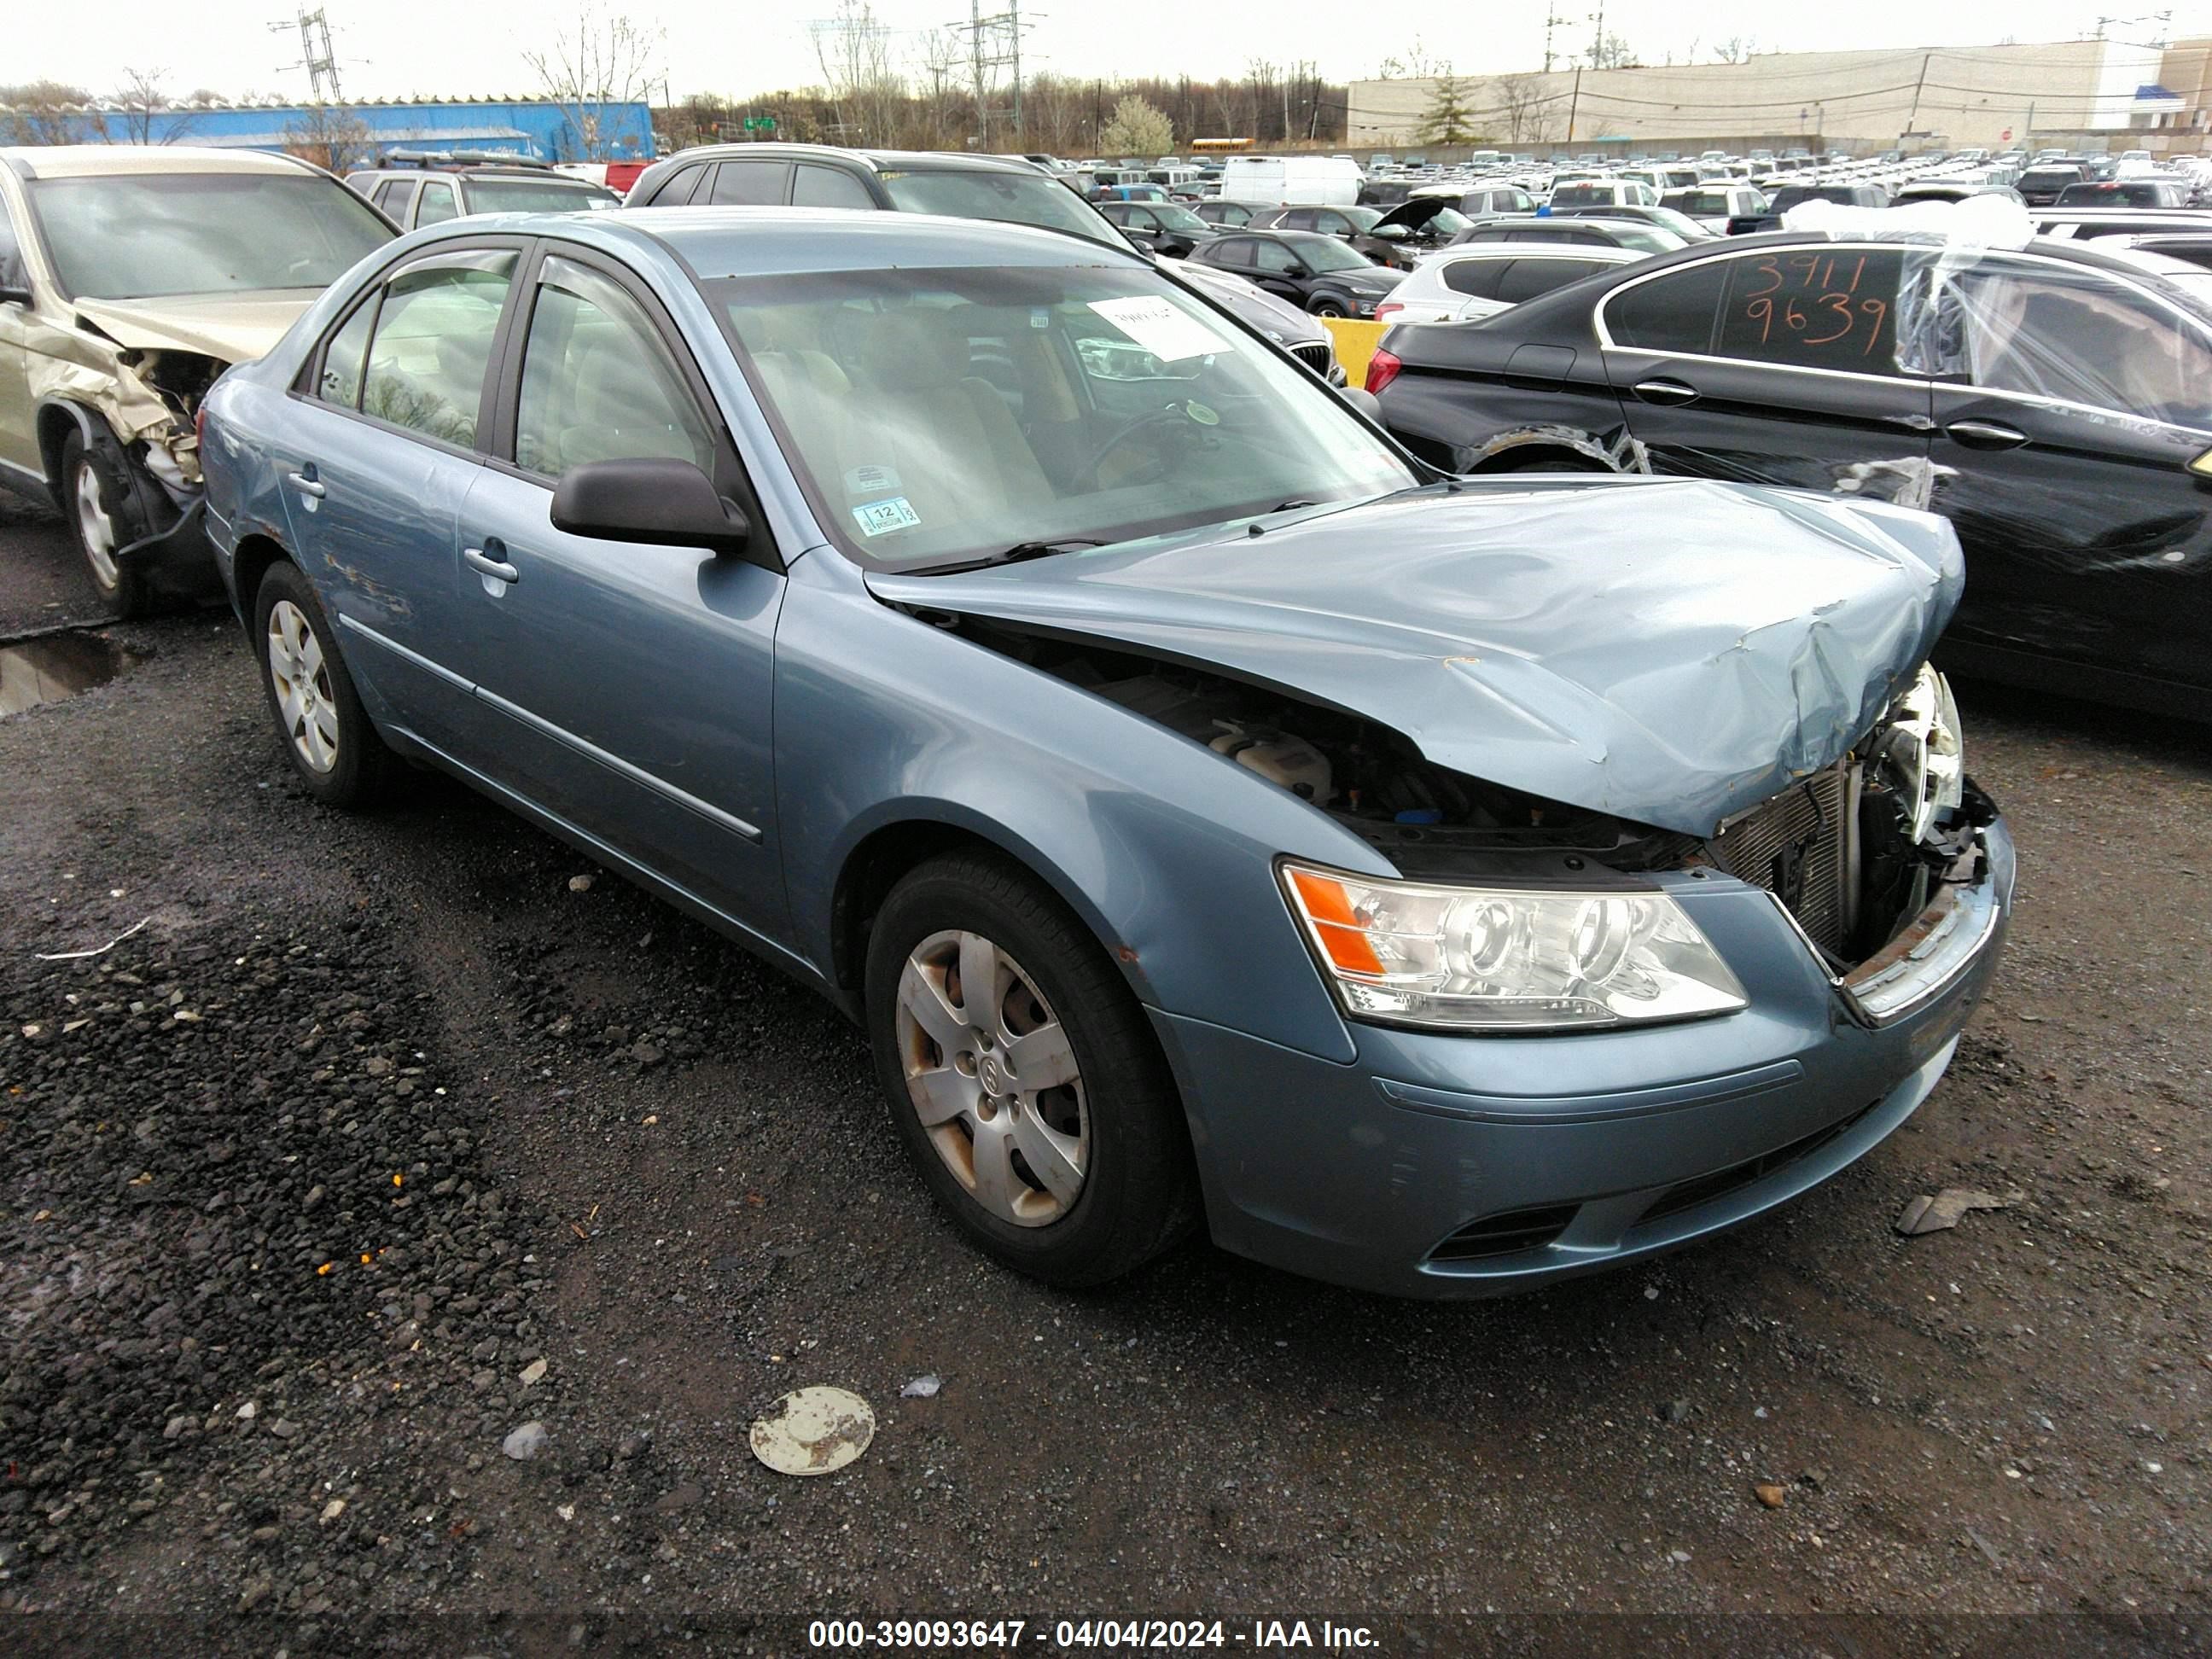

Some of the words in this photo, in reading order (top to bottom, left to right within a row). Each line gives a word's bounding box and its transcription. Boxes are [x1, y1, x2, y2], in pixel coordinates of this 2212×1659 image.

[1746, 255, 1866, 297] 3911
[1748, 294, 1886, 356] 9639
[875, 506, 895, 518] 12
